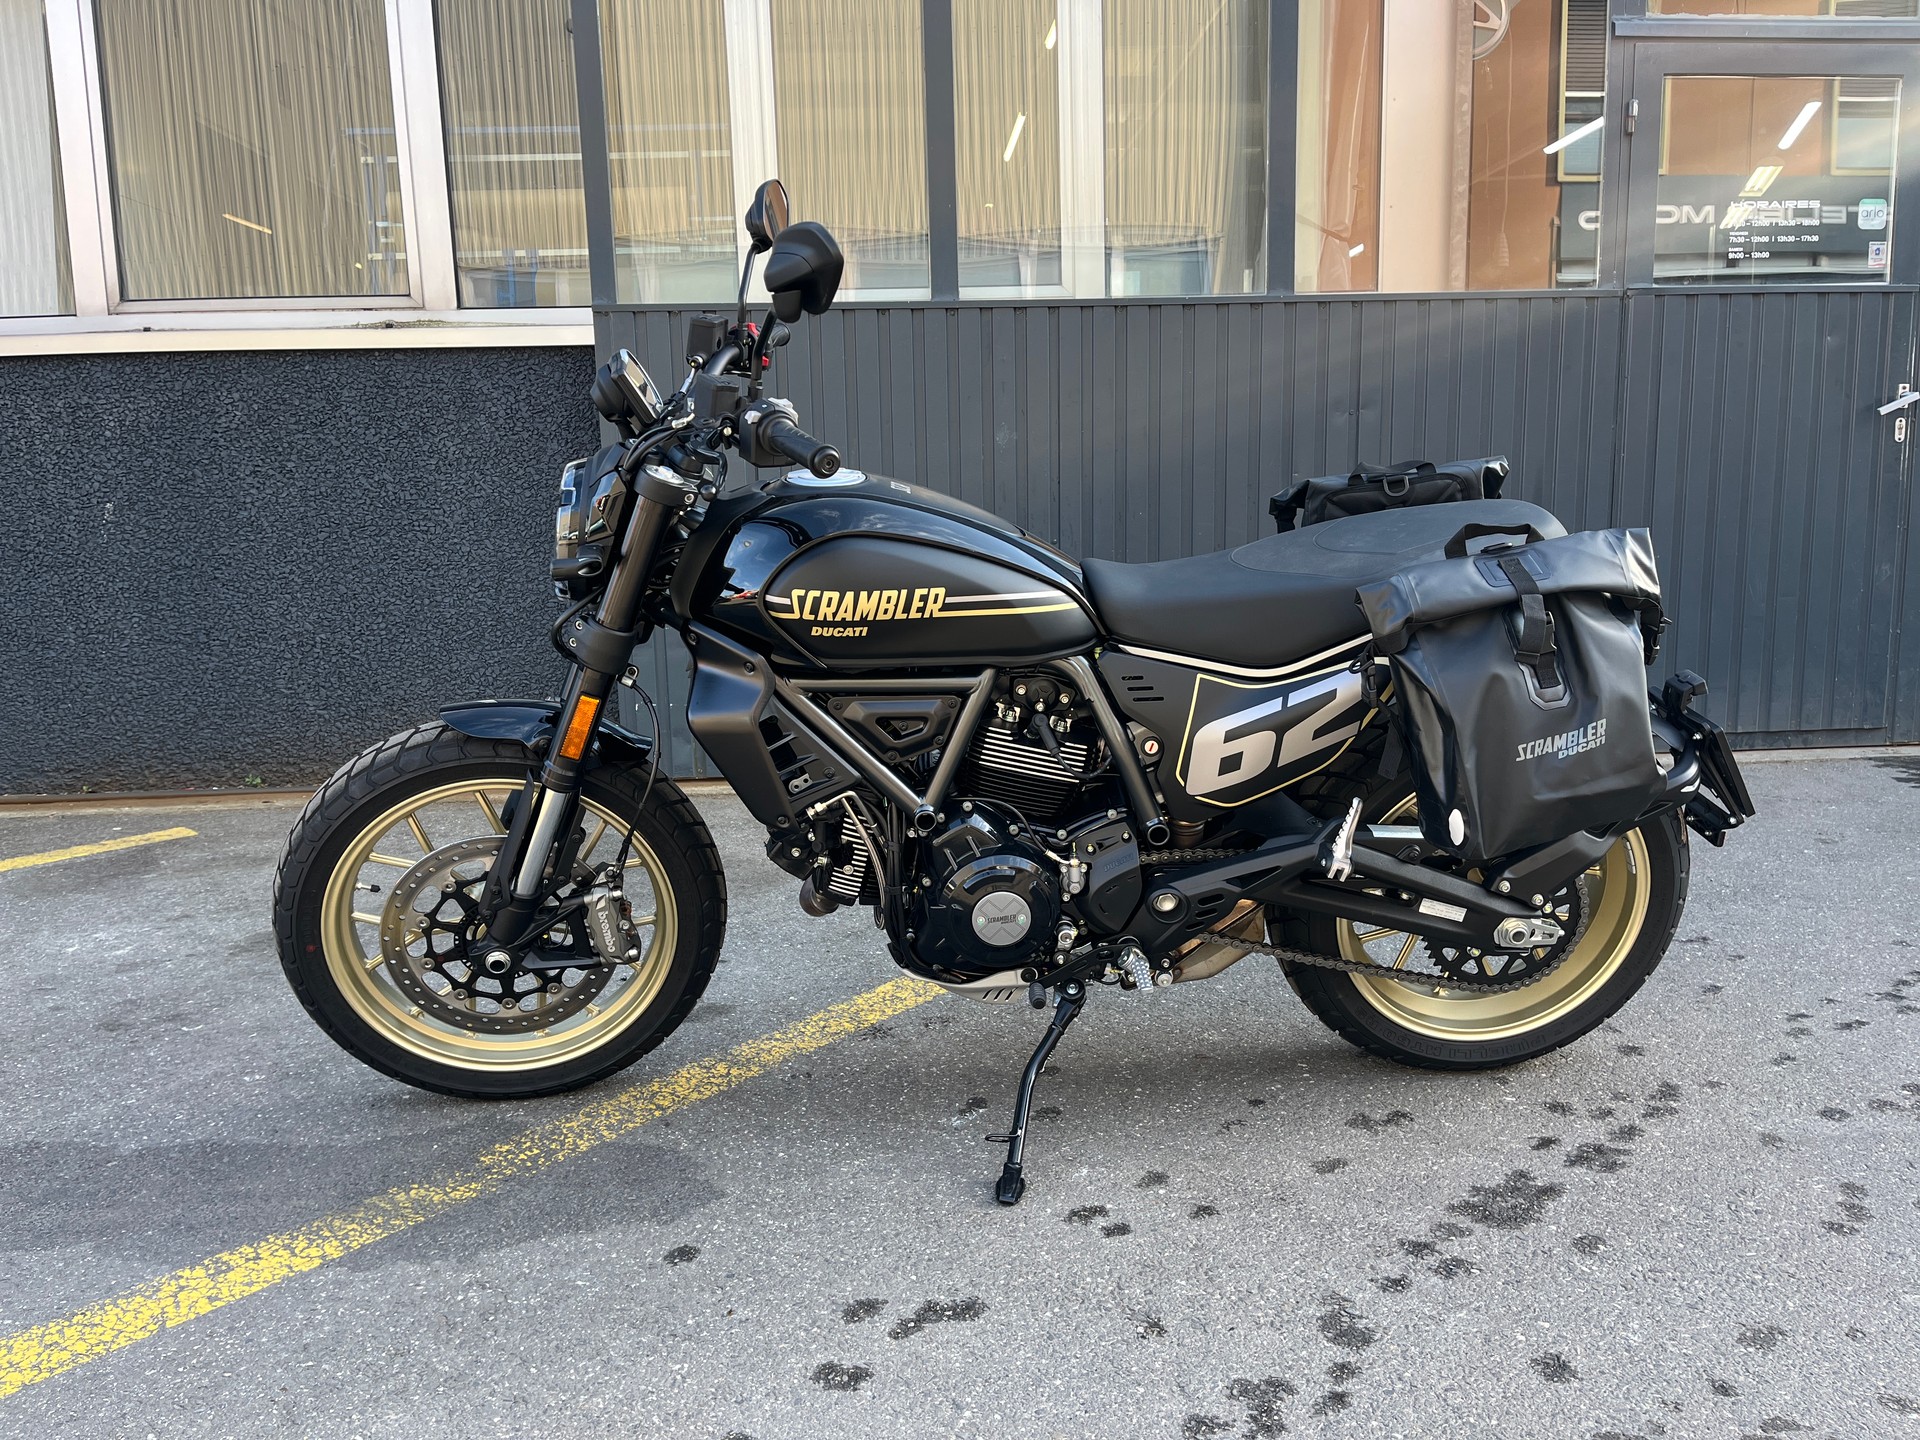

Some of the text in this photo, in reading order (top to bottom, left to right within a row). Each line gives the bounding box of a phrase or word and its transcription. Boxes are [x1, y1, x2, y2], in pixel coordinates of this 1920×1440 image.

[1861, 206, 1884, 218] arlo
[1801, 234, 1819, 242] 17h30
[790, 586, 946, 622] SCRAMBLER
[810, 626, 869, 637] DUCATI
[1185, 669, 1362, 796] 62
[1515, 718, 1607, 762] SCRAMBLER
[1558, 735, 1606, 760] DUCATI
[597, 911, 616, 953] brembo
